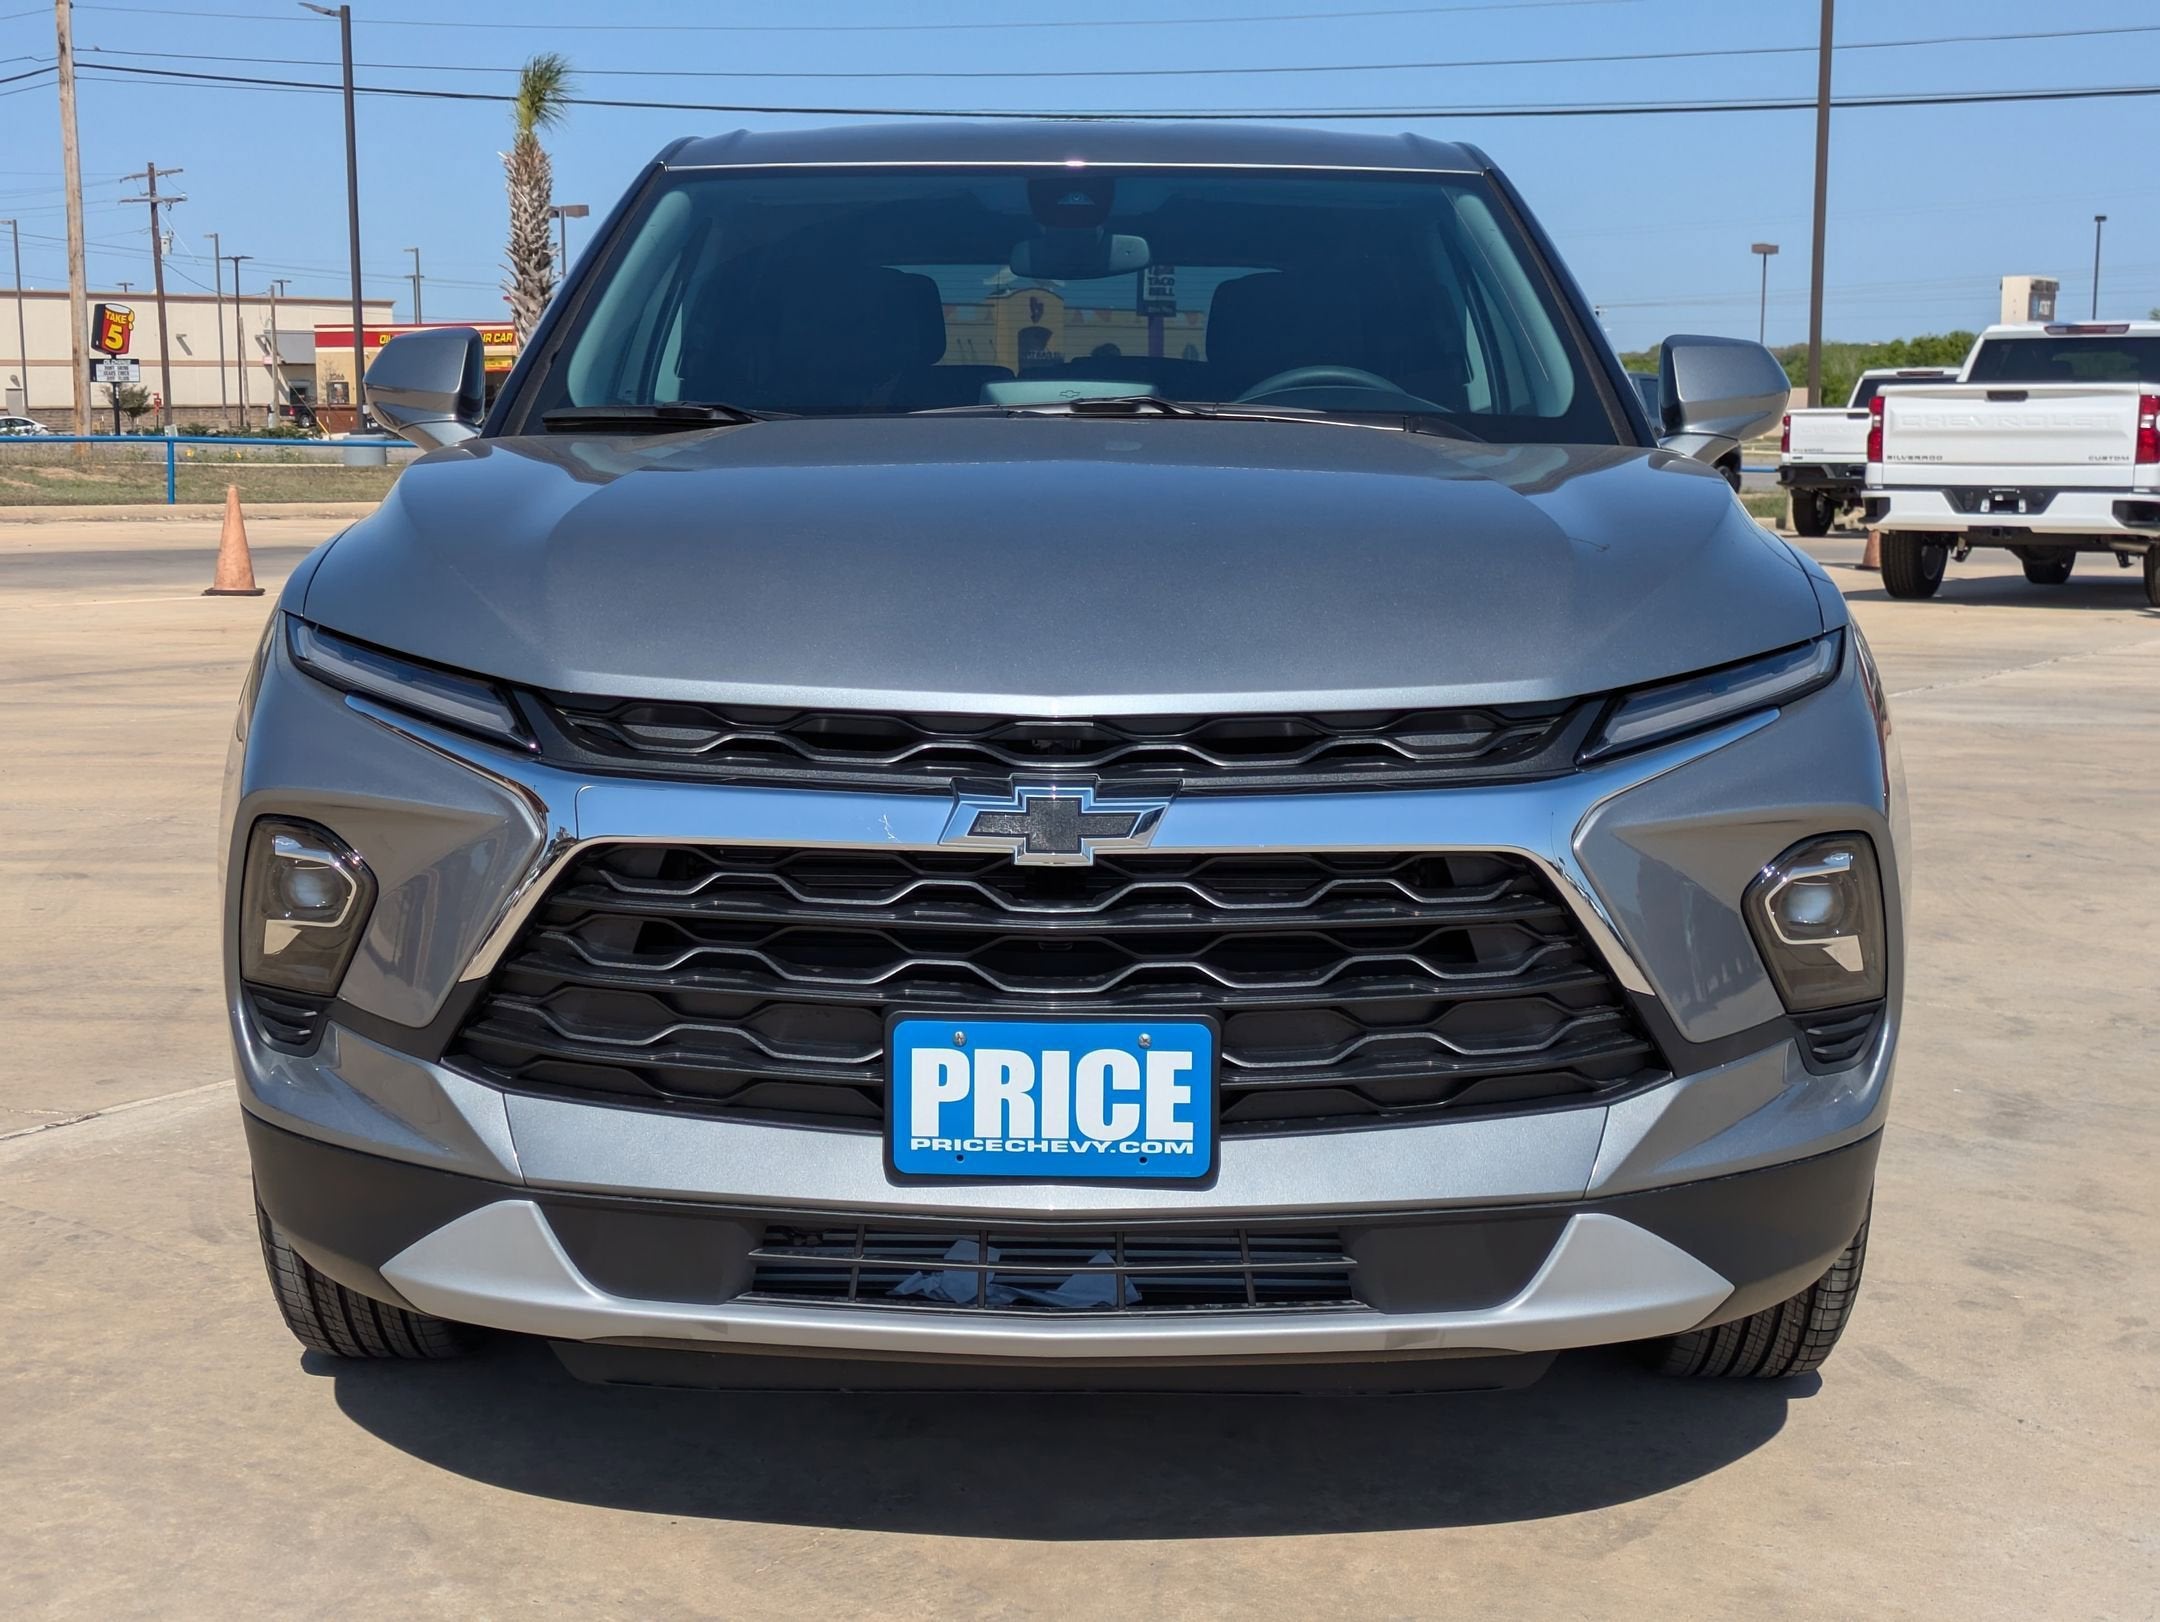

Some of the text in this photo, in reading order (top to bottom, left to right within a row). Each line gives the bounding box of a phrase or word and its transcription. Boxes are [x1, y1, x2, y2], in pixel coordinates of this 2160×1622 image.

[105, 311, 128, 324] TAKE
[105, 324, 124, 350] 5
[493, 332, 514, 343] CAR
[1901, 413, 2116, 430] CHEVROLET
[911, 1047, 1194, 1142] PRICE
[911, 1138, 1194, 1155] PRICECHEVY.COM
